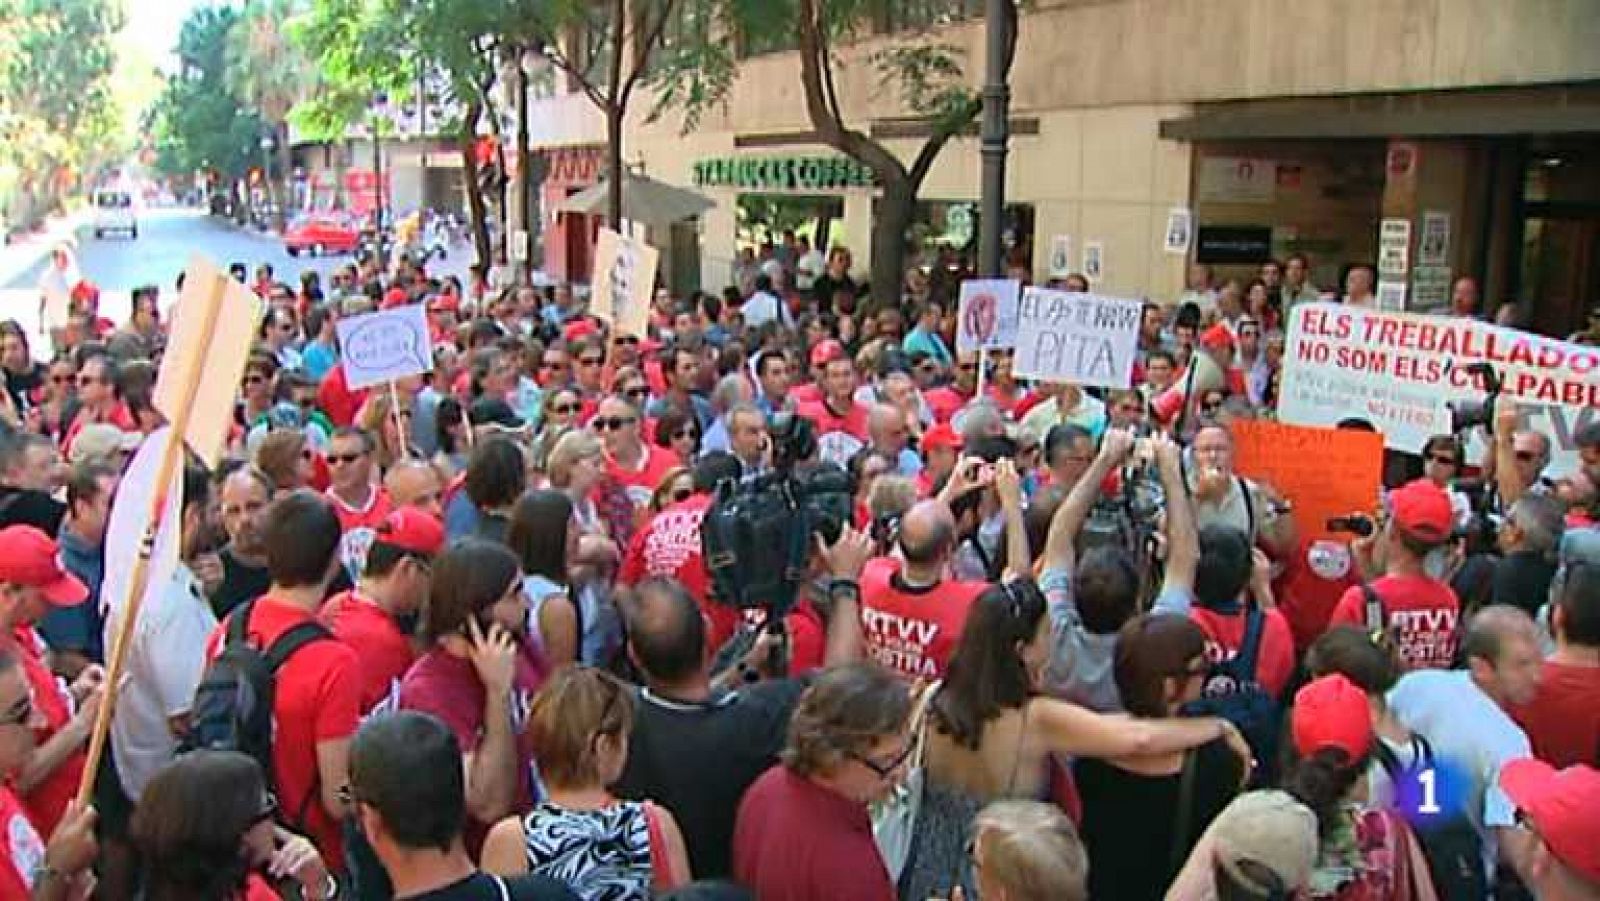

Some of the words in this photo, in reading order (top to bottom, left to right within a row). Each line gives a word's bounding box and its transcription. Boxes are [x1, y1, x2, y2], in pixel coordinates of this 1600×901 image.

[1033, 330, 1117, 377] PITA
[1298, 340, 1331, 364] NO
[1336, 345, 1387, 374] SOM
[1394, 356, 1442, 384] ELS
[1301, 308, 1353, 339] ELS
[1363, 315, 1599, 373] TREBALLADO
[862, 608, 938, 645] RTVV
[866, 645, 938, 675] OSTRA
